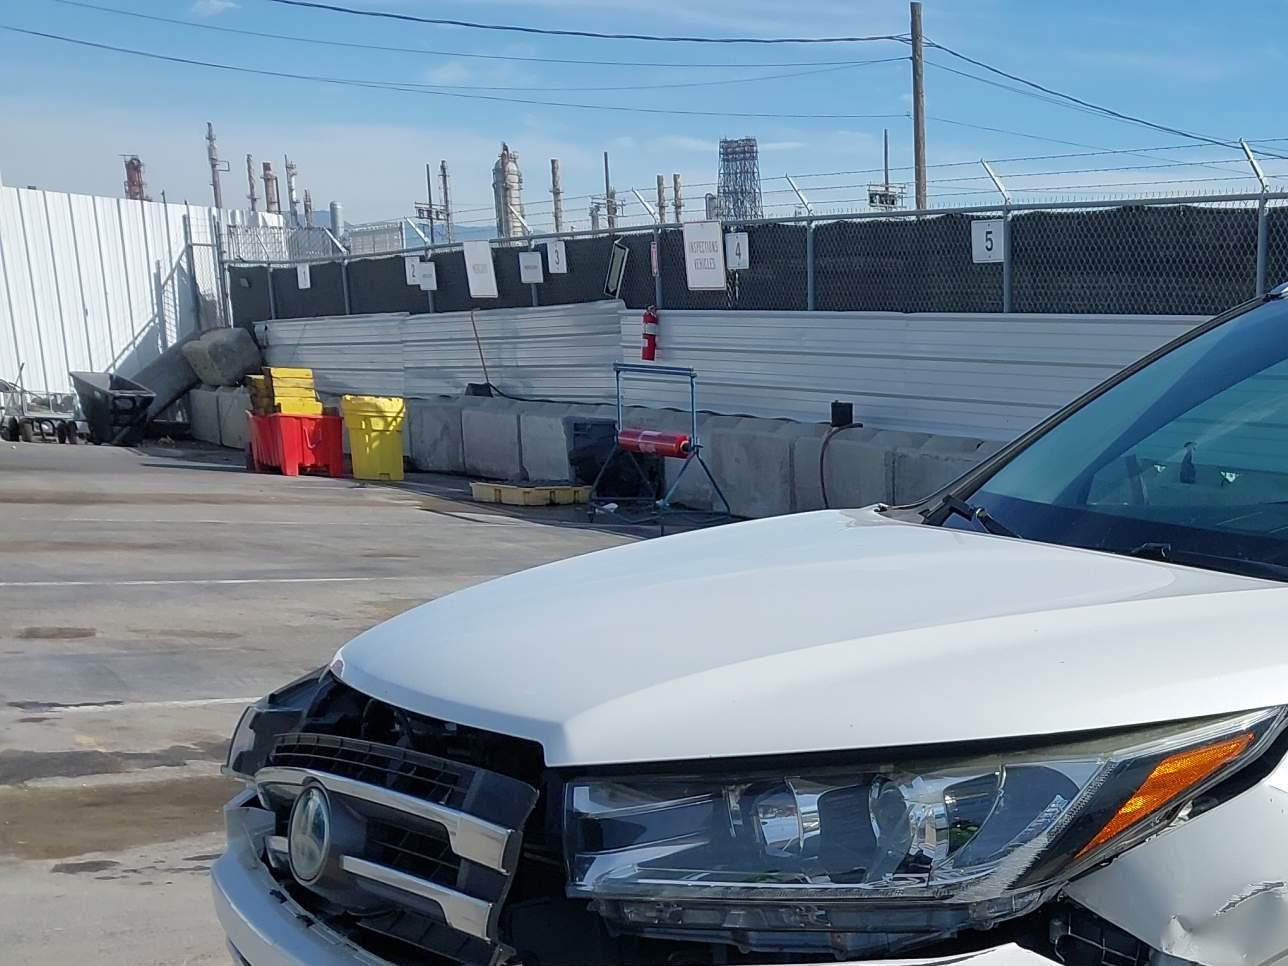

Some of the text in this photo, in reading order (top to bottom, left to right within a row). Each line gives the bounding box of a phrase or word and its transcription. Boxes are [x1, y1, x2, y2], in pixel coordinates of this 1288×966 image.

[985, 230, 994, 252] 5
[554, 248, 561, 265] 3
[735, 242, 742, 260] 4
